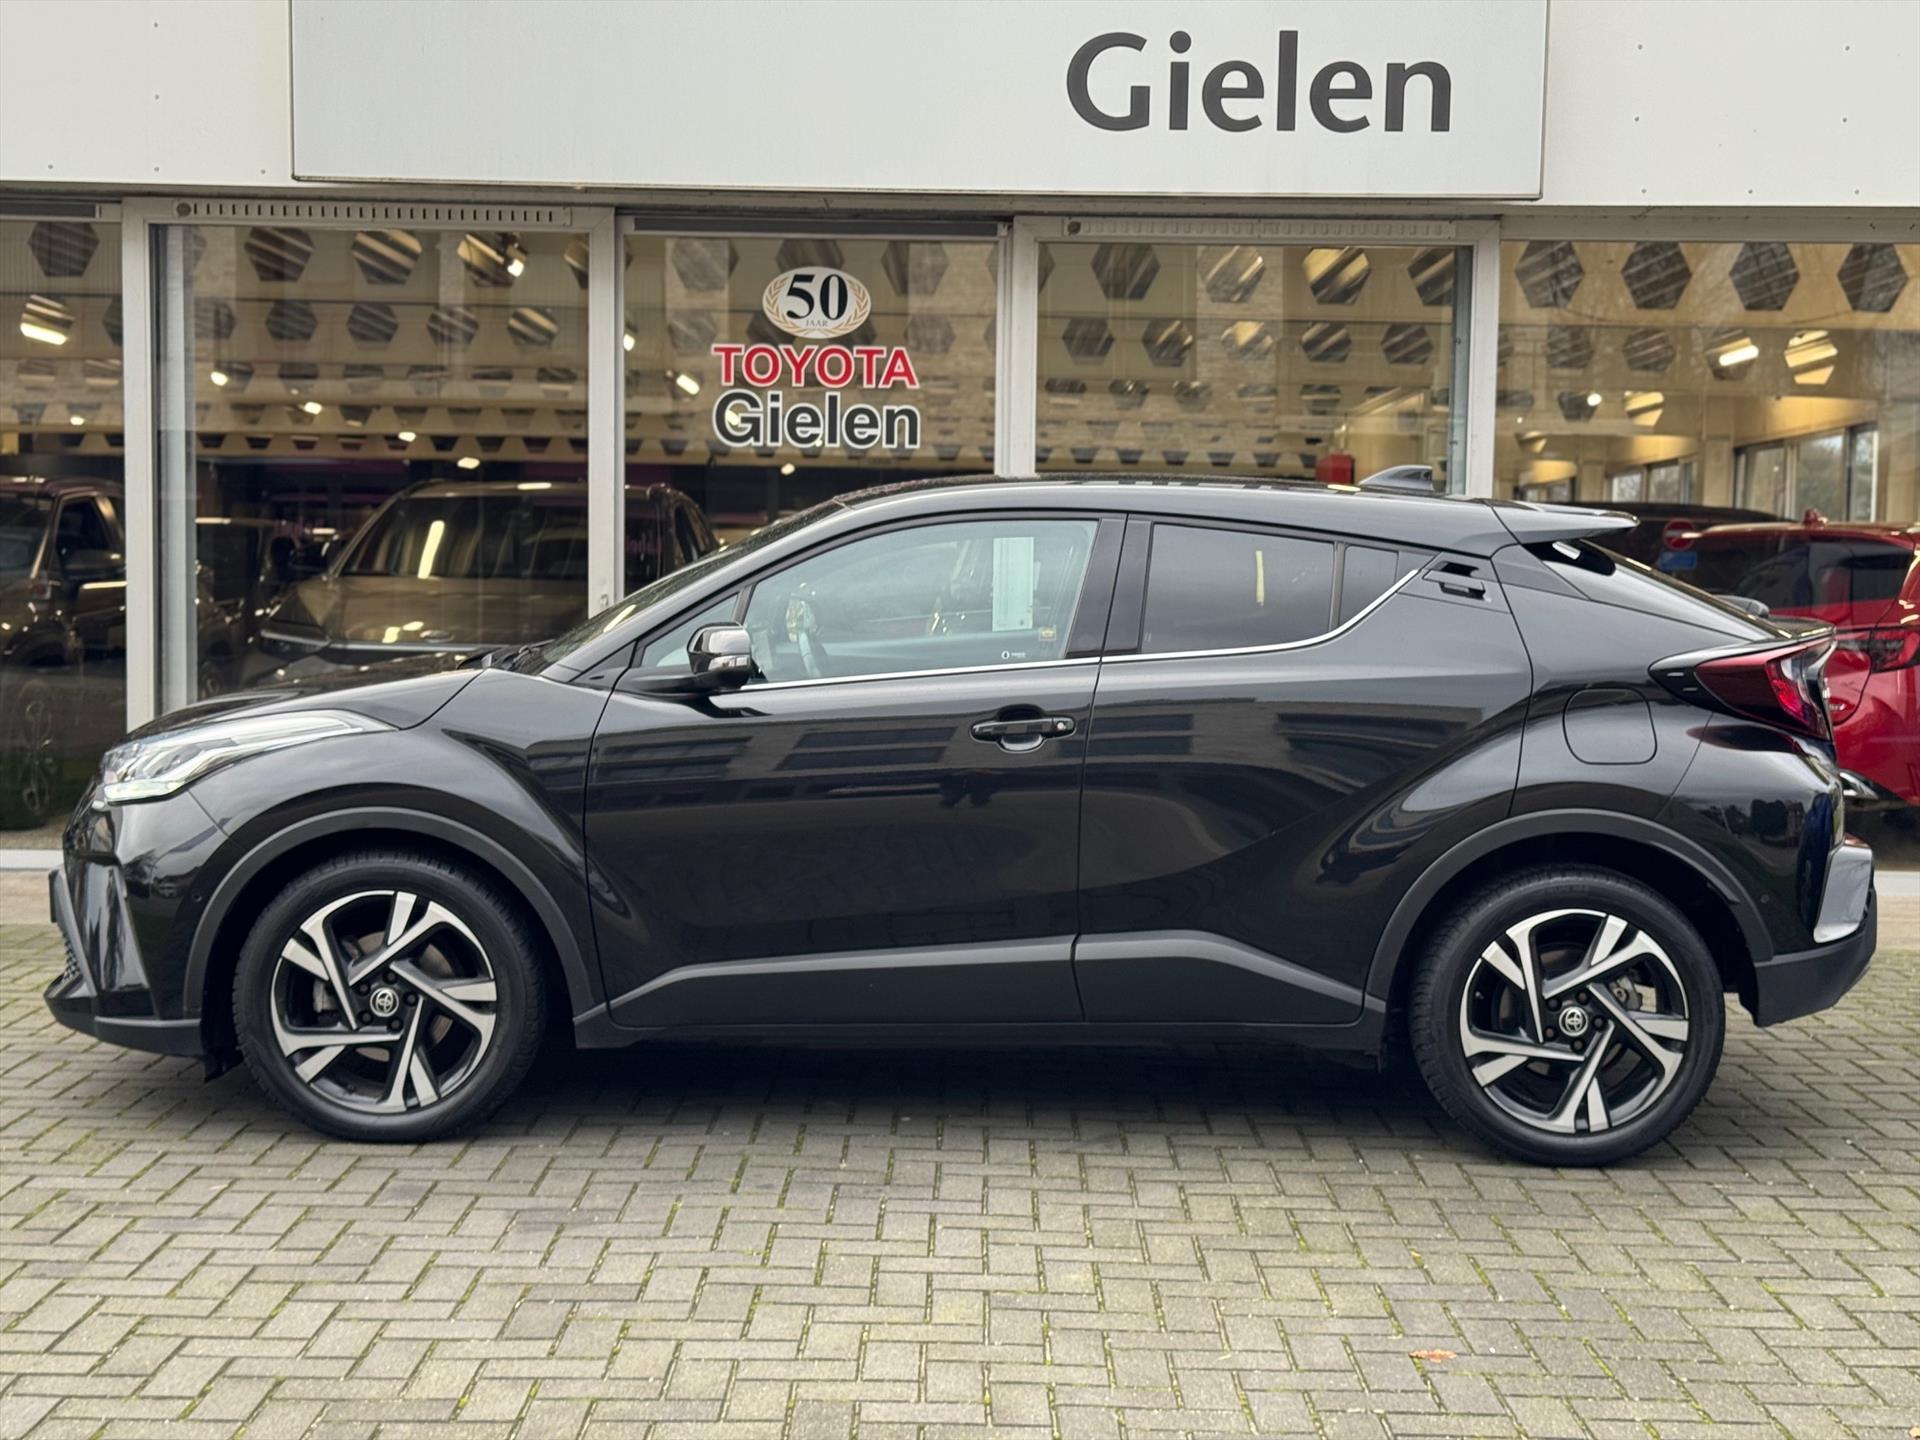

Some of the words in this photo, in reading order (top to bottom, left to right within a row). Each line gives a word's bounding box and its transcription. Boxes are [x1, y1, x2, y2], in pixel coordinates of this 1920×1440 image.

[1066, 30, 1452, 133] Gielen
[786, 273, 849, 320] 50
[712, 344, 920, 389] TOYOTA
[713, 389, 920, 449] Gielen
